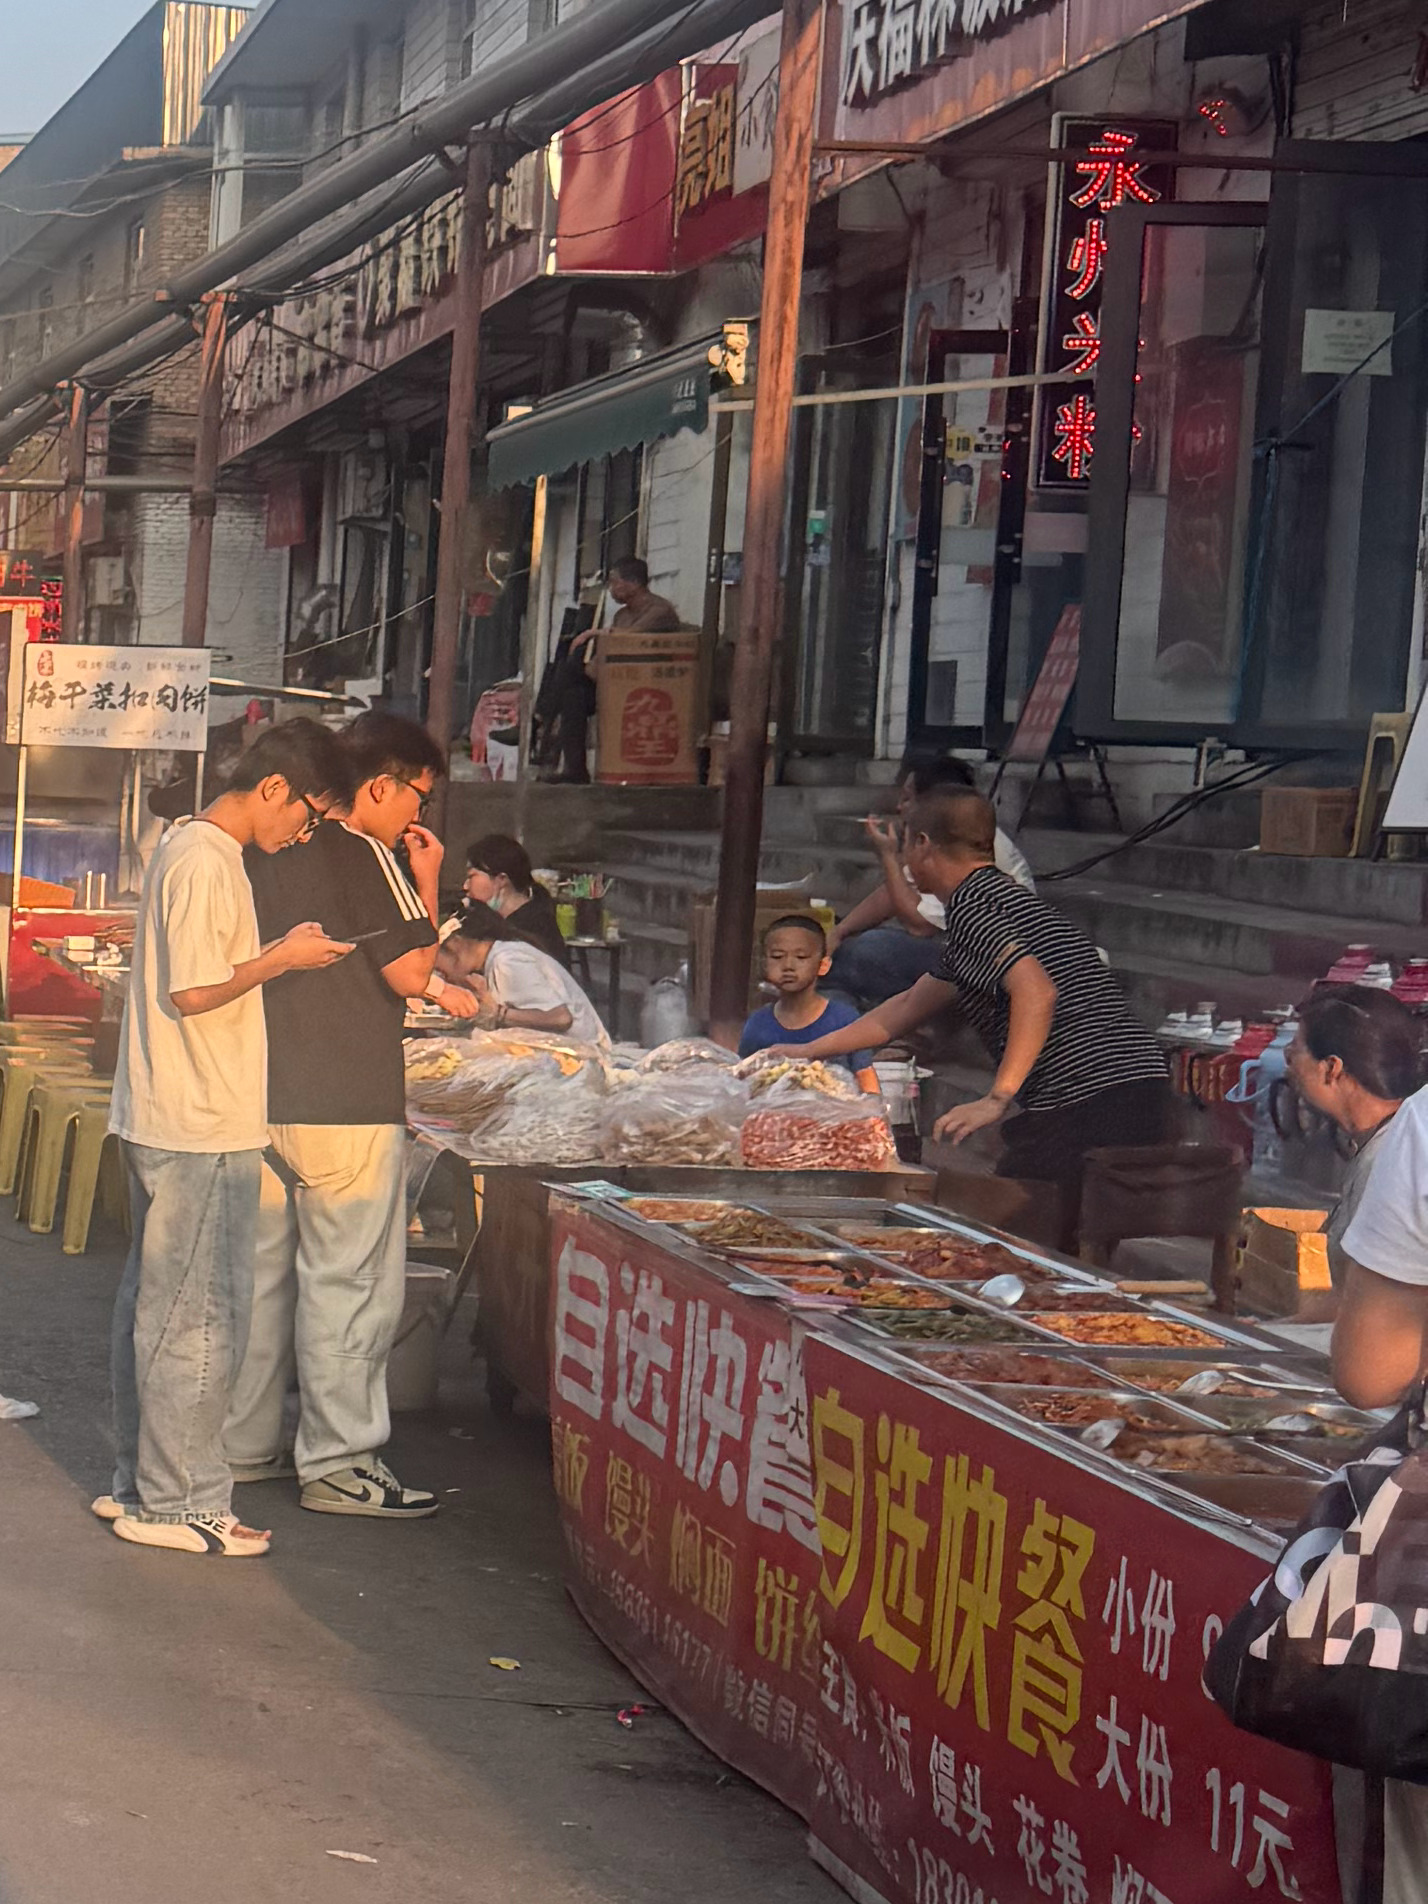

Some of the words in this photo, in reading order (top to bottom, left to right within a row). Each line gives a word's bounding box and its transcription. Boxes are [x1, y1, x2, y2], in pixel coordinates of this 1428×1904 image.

[26, 680, 208, 715] 梅干菜扣肉饼
[555, 1234, 823, 1557] 自选快餐
[812, 1385, 1097, 1789] 自选快餐
[1102, 1555, 1178, 1682] 小份
[929, 1733, 995, 1856] 馒头
[1095, 1695, 1174, 1828] 大份
[1205, 1767, 1304, 1903] 11元
